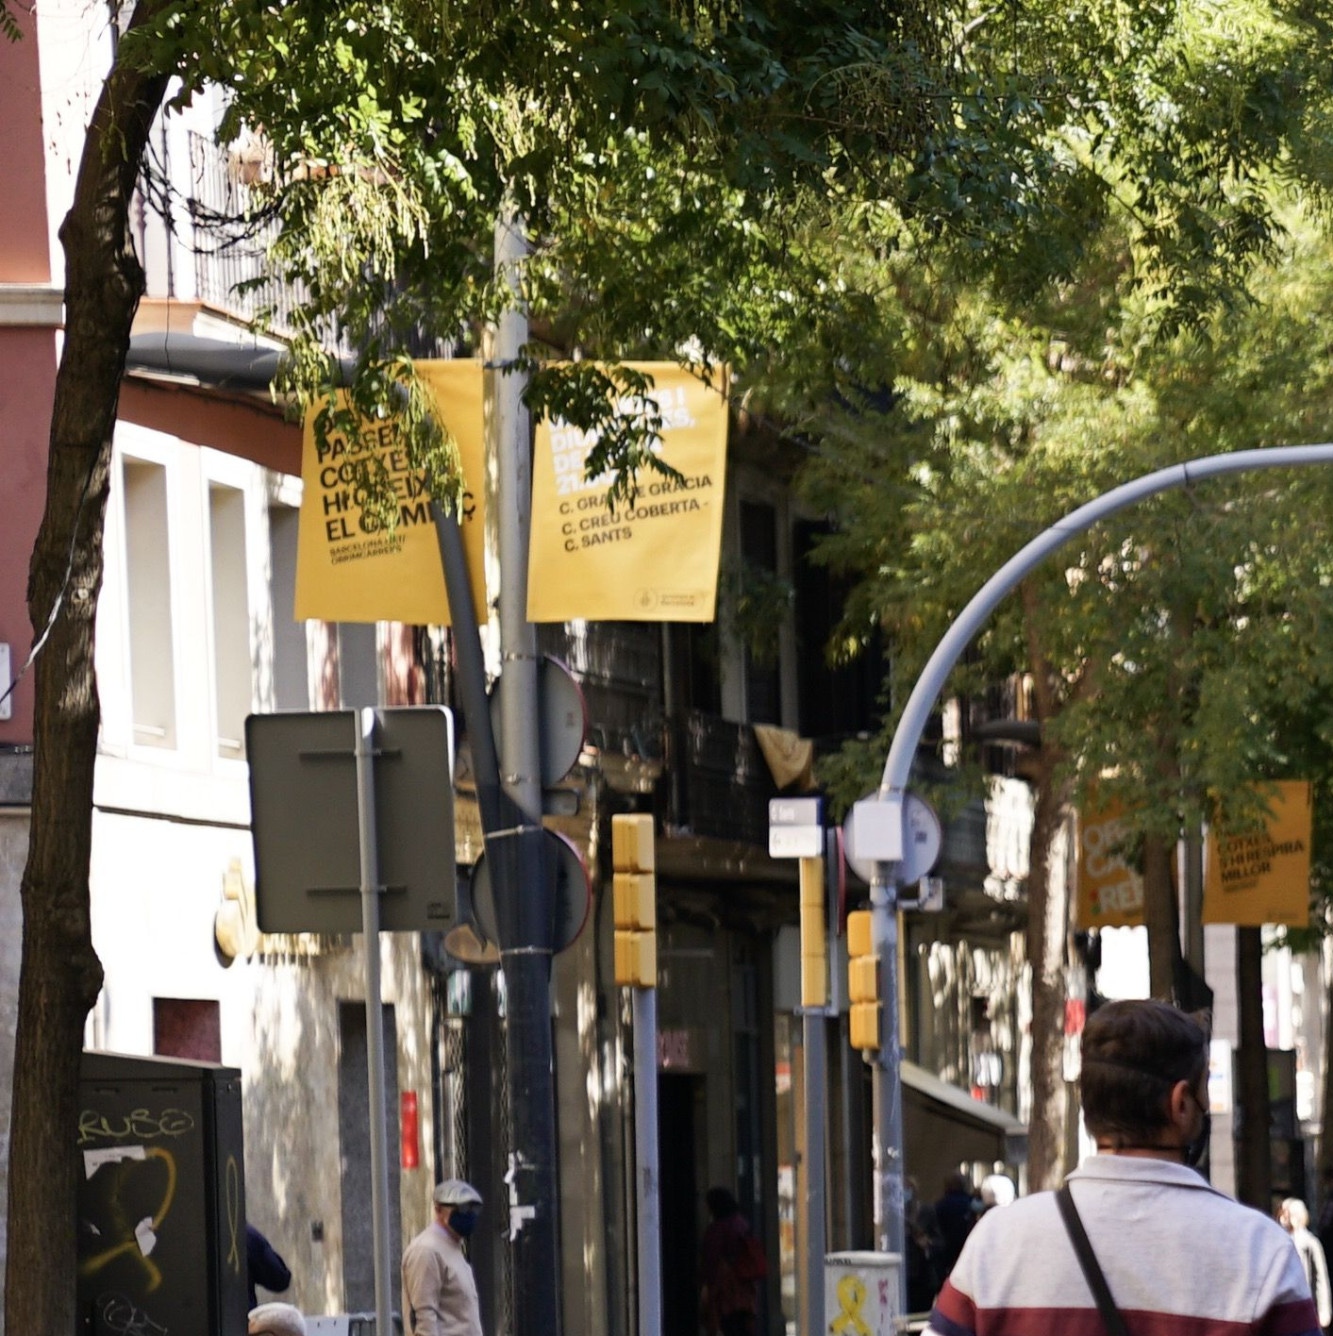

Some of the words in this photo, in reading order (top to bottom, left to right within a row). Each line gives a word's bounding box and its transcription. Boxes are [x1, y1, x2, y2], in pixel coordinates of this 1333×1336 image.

[320, 448, 411, 489] COTXE
[353, 473, 430, 508] CEIX
[326, 516, 356, 543] EL
[579, 511, 621, 531] CREU
[624, 498, 700, 522] COBERTA
[581, 526, 632, 548] SANTS
